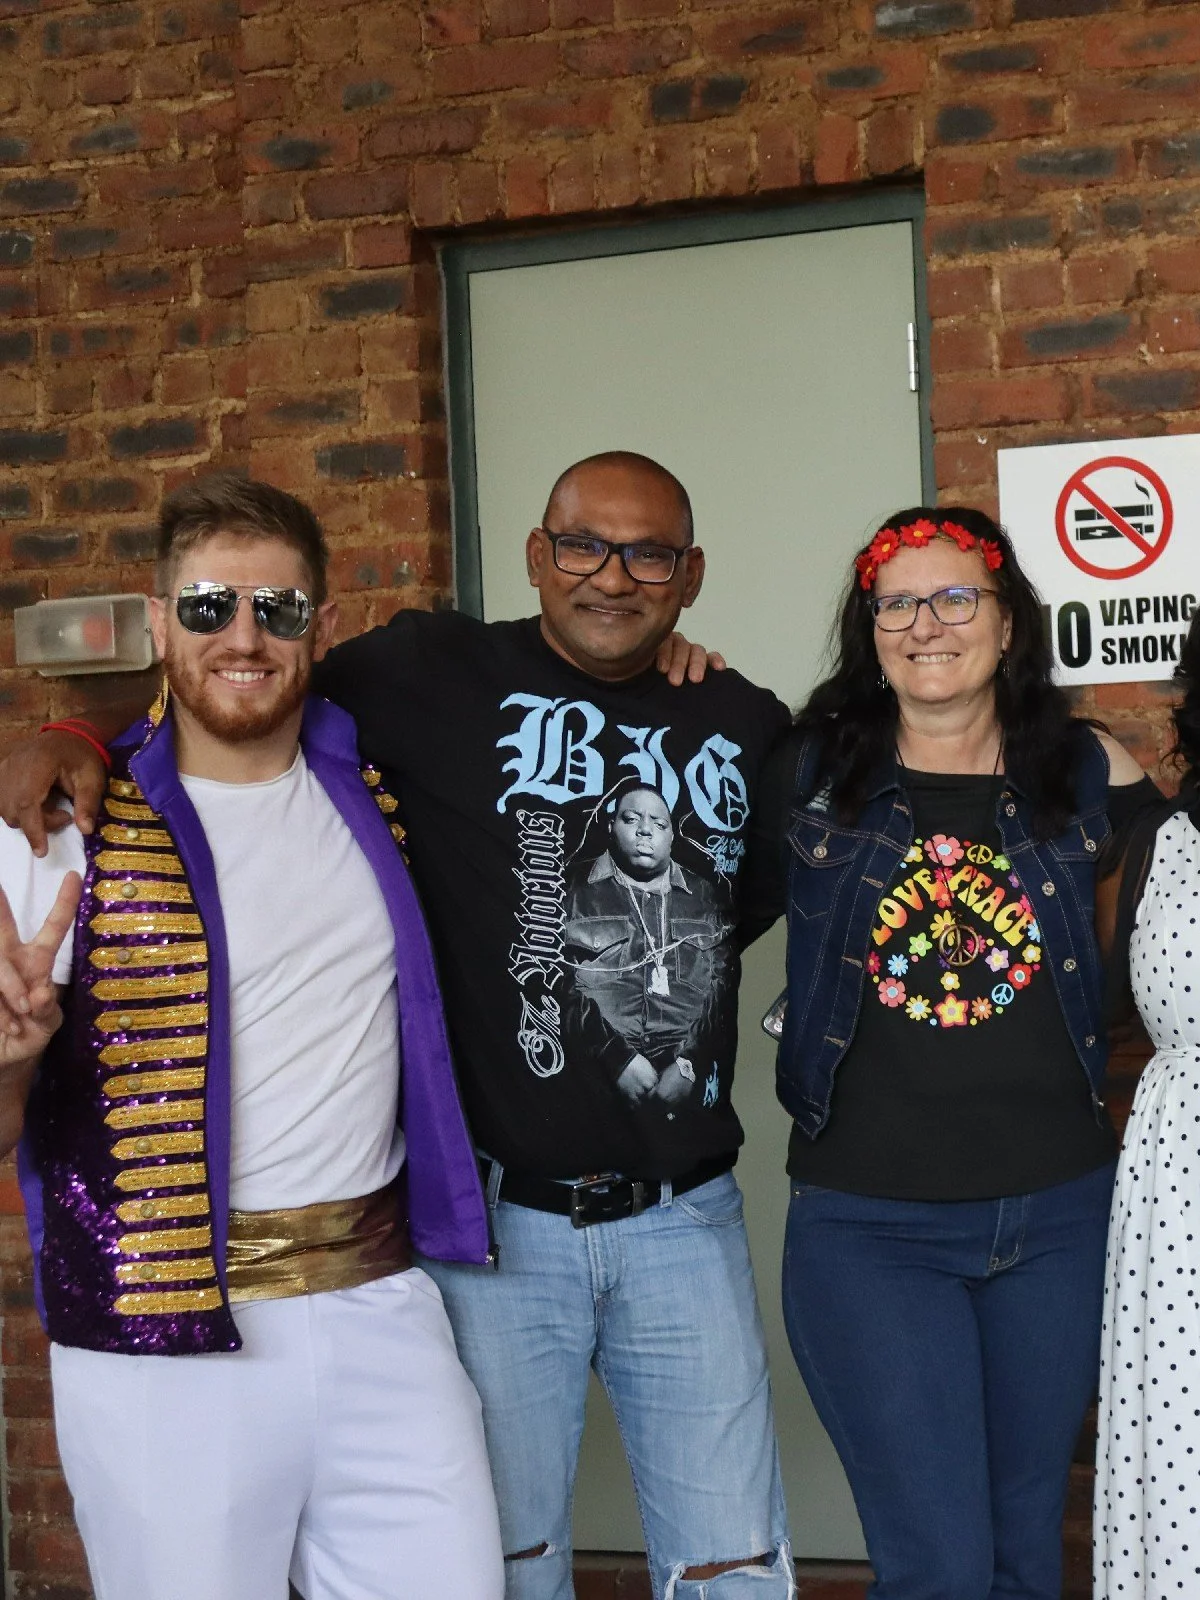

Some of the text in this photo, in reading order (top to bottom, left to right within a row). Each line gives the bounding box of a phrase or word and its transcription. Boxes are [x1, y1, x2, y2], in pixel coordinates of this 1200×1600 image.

[1100, 594, 1199, 627] VAPING
[508, 808, 568, 1078] The Notorious
[871, 865, 1035, 947] LOVE PEACE
